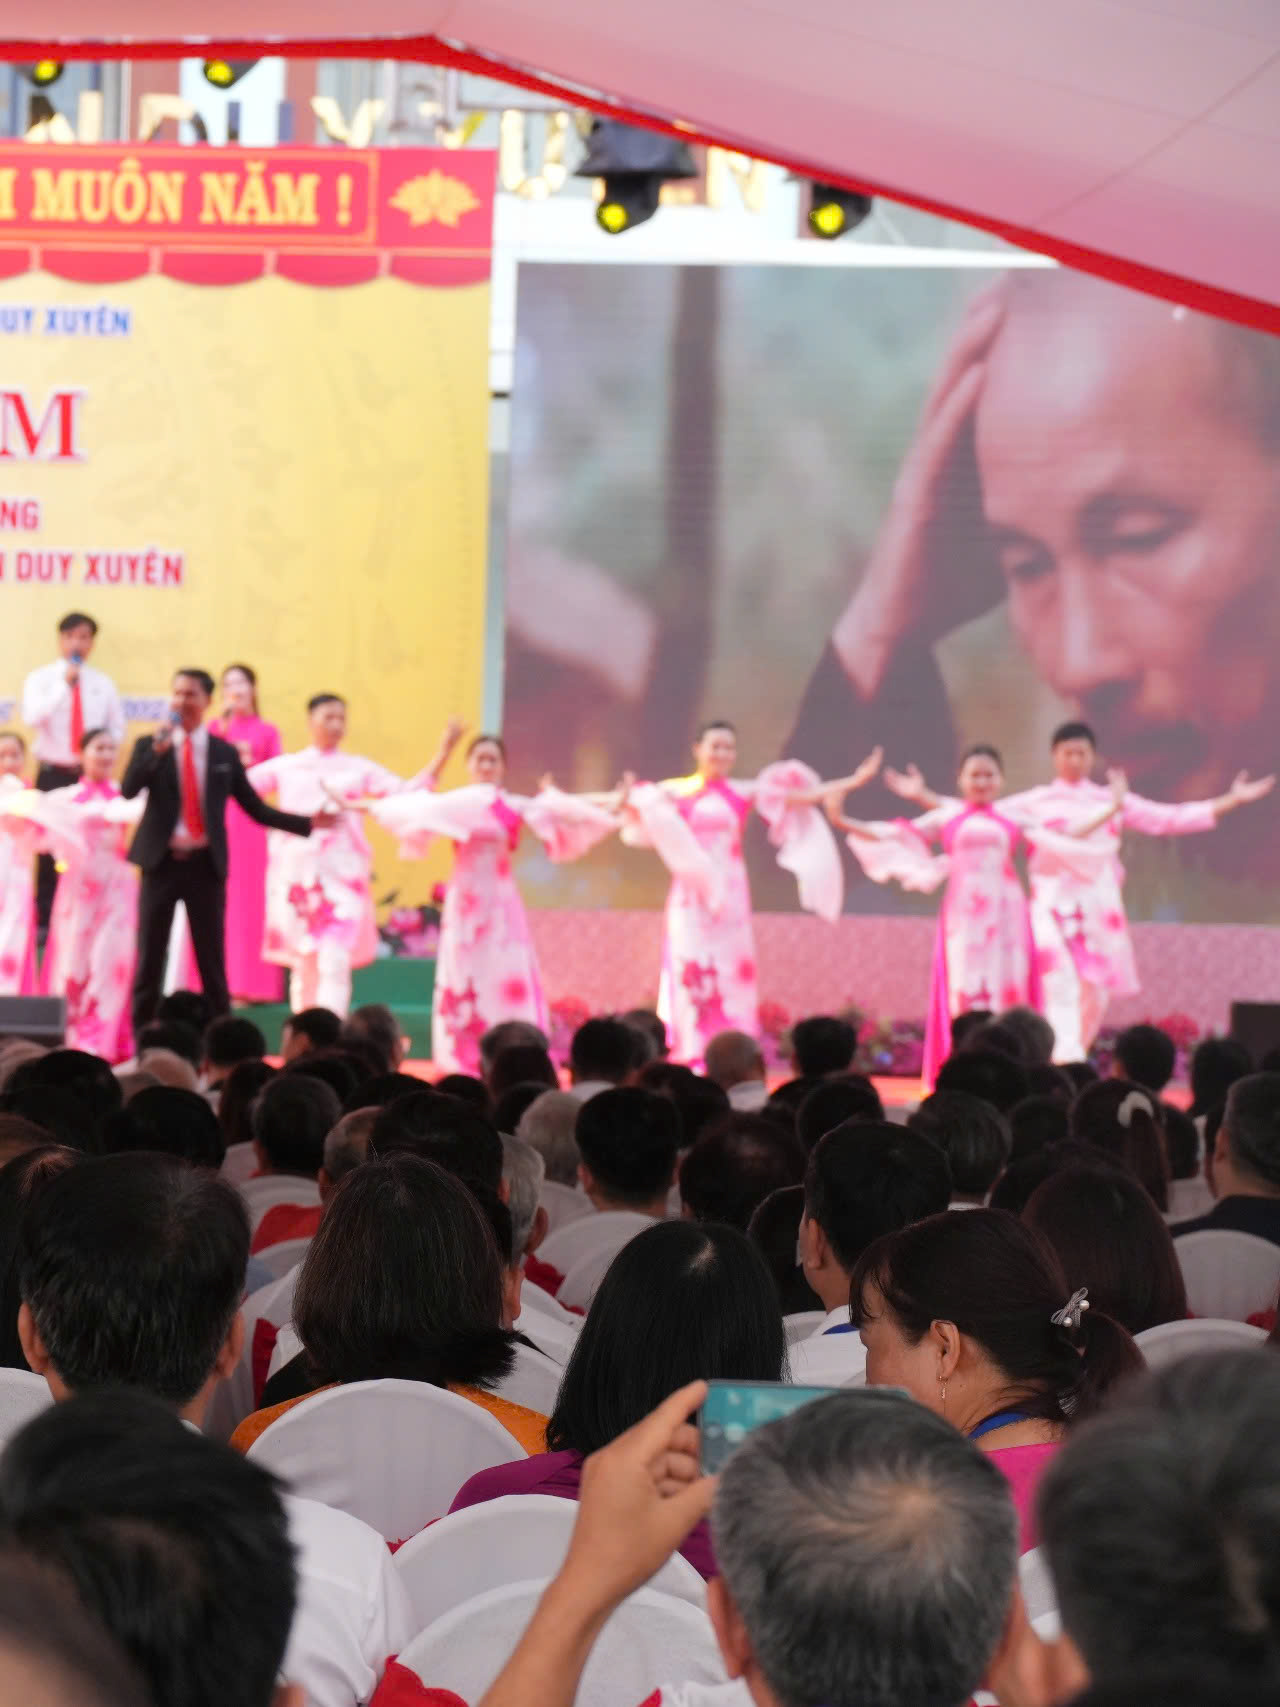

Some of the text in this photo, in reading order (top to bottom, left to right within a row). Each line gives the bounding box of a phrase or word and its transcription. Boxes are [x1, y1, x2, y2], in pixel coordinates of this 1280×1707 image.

[30, 156, 186, 225] MUÔN
[199, 160, 321, 226] NĂM
[335, 173, 363, 227] !
[42, 301, 132, 335] XUYÊN
[16, 551, 74, 582] DUY
[82, 547, 184, 586] XUYÊN
